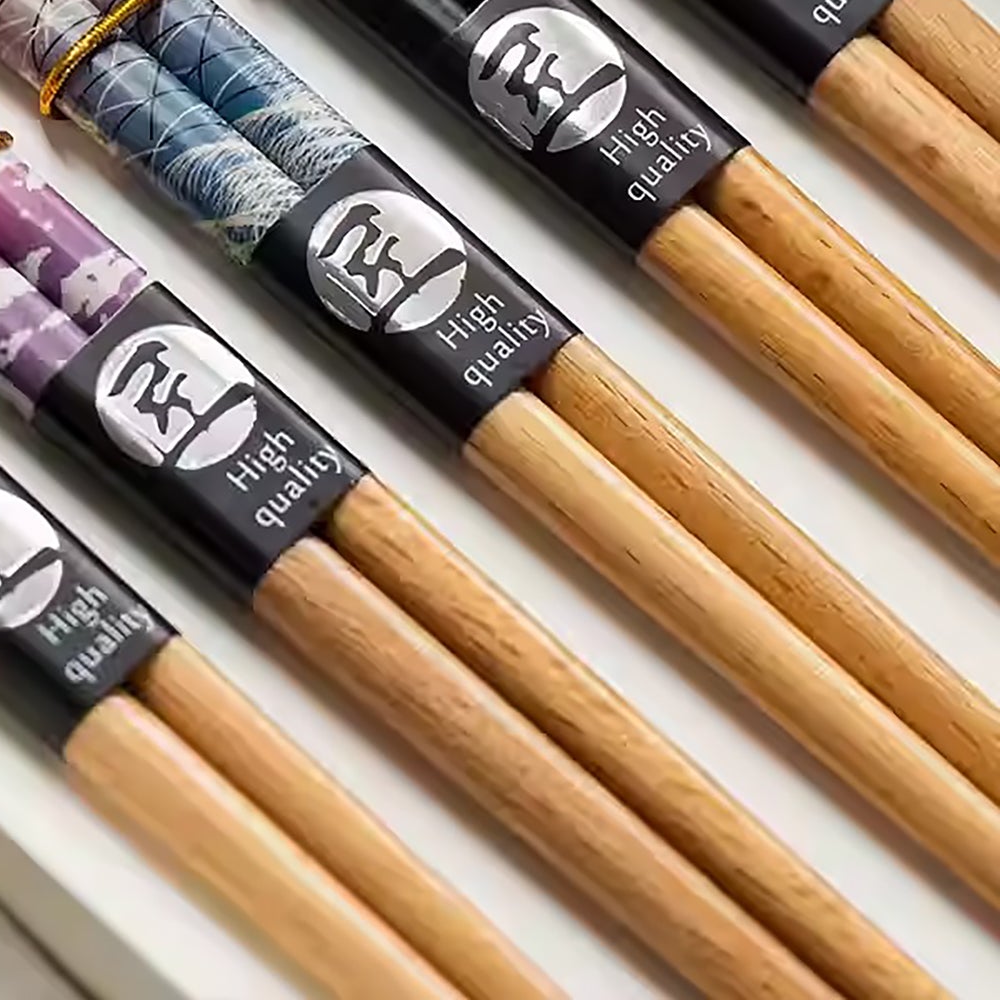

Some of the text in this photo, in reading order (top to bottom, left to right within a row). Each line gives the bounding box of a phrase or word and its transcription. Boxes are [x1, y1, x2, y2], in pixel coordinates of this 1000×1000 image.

[599, 107, 668, 166] High
[626, 123, 712, 202] quality
[435, 292, 506, 350] High
[462, 308, 551, 388] quality
[225, 430, 296, 492] High
[254, 445, 342, 529] quality
[36, 583, 109, 646] High
[63, 602, 156, 684] quality
